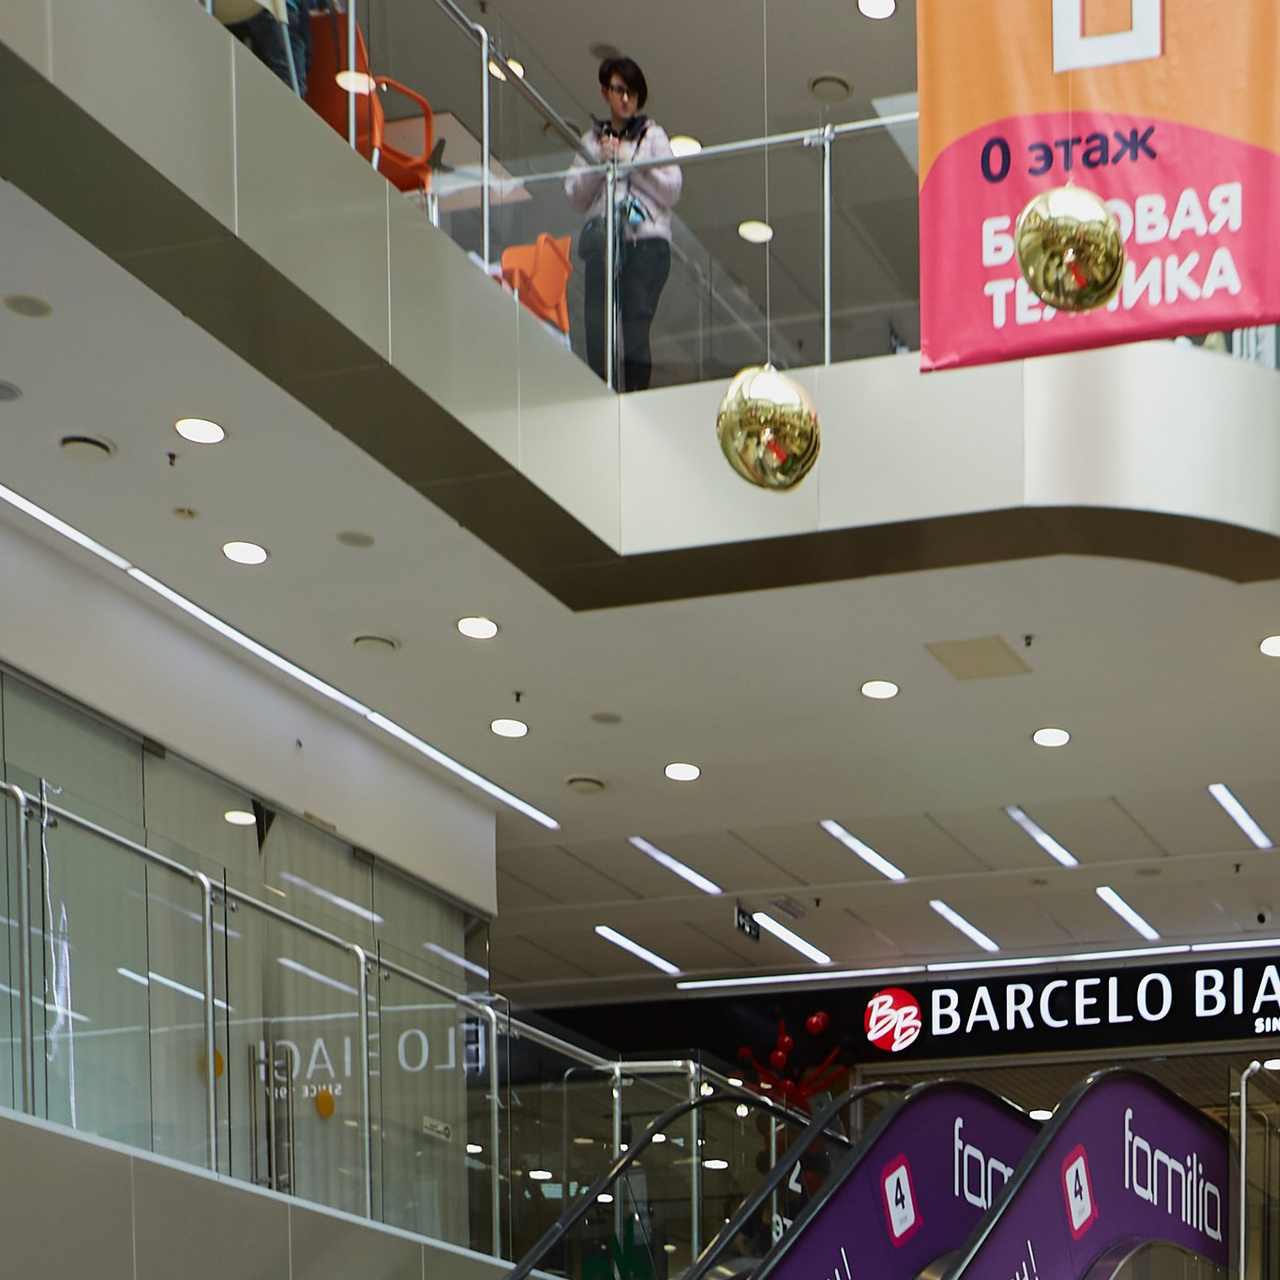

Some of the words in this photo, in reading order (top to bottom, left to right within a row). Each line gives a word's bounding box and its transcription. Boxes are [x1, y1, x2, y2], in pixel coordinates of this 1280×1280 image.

[981, 137, 1011, 183] 0
[1028, 126, 1157, 176] этаж
[981, 182, 1242, 267] БОВАЯ
[984, 247, 1242, 329] ТЕИКА
[932, 973, 1172, 1035] BARCELO
[894, 1176, 905, 1210] 4
[1074, 1167, 1083, 1201] 4
[1125, 1108, 1222, 1242] familia
